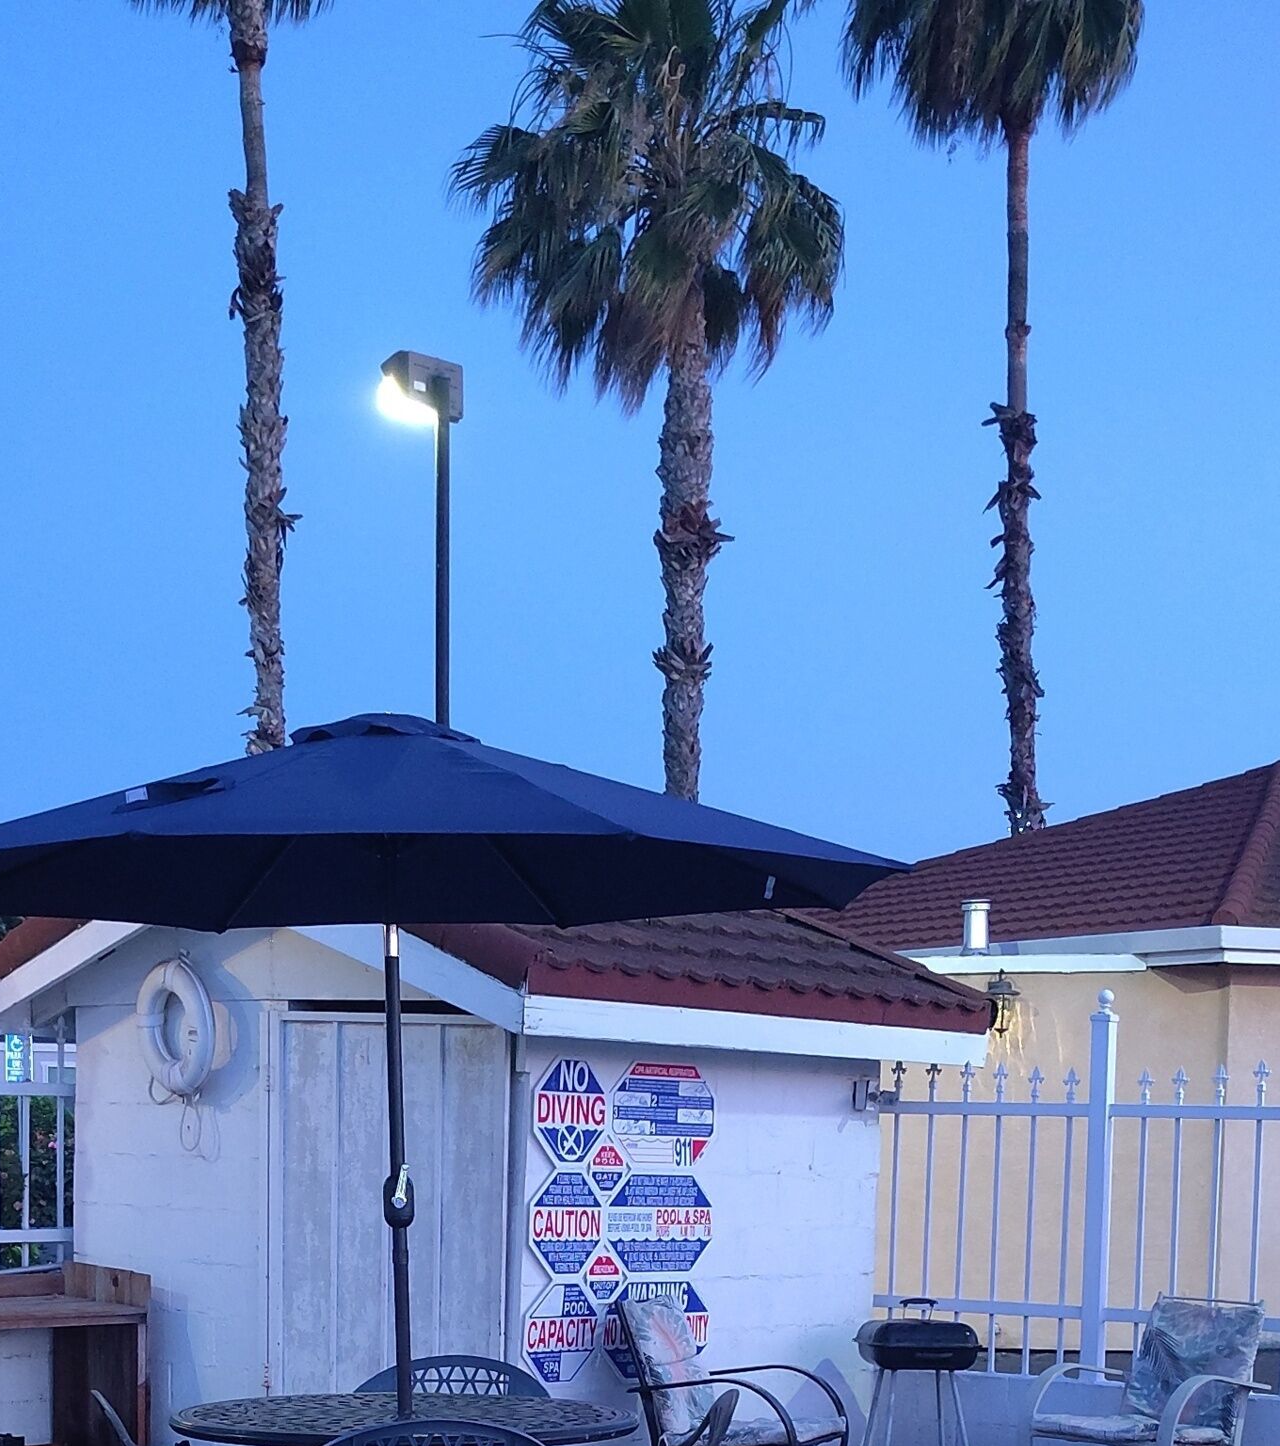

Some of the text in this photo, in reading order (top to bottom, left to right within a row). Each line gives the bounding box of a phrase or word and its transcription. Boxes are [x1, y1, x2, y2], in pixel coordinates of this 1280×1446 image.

[560, 1061, 589, 1092] NO
[625, 1079, 629, 1090] 1
[651, 1095, 658, 1107] 2
[538, 1094, 606, 1126] DIVING
[613, 1107, 618, 1118] 3
[649, 1122, 656, 1134] 4
[675, 1138, 692, 1166] 911
[533, 1210, 600, 1238] CAUTION
[657, 1209, 681, 1225] POOL
[685, 1210, 691, 1224] &
[693, 1209, 711, 1225] SPA
[563, 1301, 590, 1315] POOL
[527, 1319, 598, 1349] CAPACITY
[603, 1317, 616, 1345] NO
[543, 1362, 559, 1373] SPA
